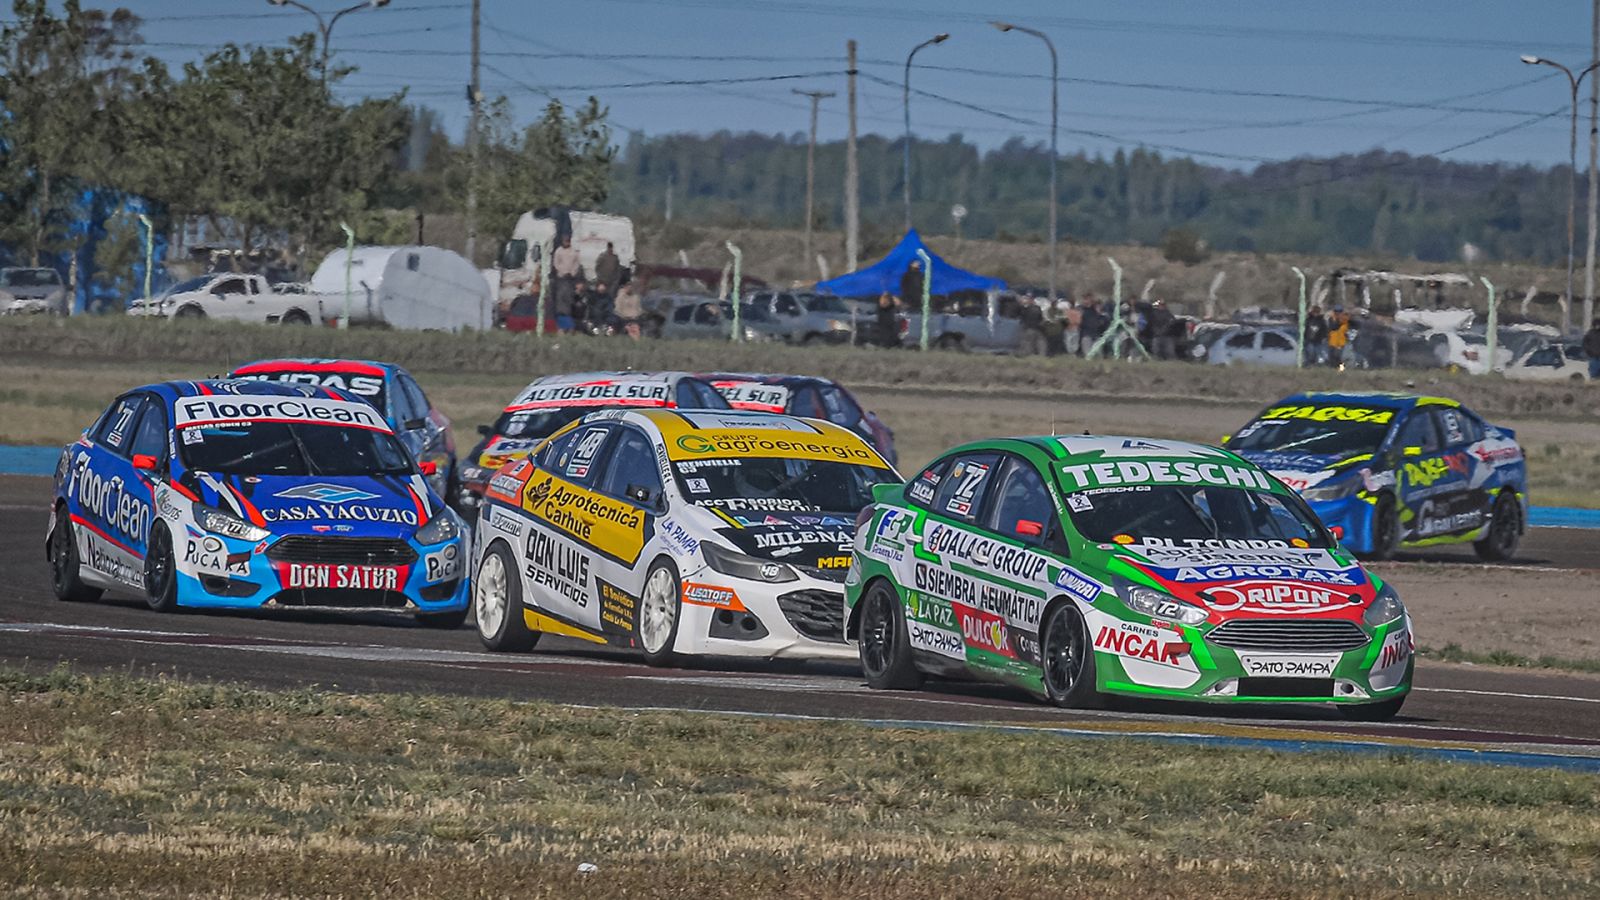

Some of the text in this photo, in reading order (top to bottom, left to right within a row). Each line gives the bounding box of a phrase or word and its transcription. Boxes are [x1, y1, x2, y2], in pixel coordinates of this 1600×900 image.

[524, 385, 665, 402] AUTOS DEL SUR
[745, 390, 781, 404] SUR
[184, 402, 375, 426] FloorClean
[578, 431, 607, 459] 48
[955, 466, 986, 498] 72
[1062, 461, 1272, 490] TEDESCHI
[1083, 487, 1134, 496] TEDESCHI
[261, 504, 418, 526] CASA YACUZIO
[549, 486, 640, 530] Agrotécnica
[227, 522, 242, 534] 77
[661, 516, 675, 533] LA
[671, 525, 700, 556] PAMPA
[754, 531, 855, 549] MILENA
[1142, 537, 1176, 548] DI
[525, 527, 590, 588] DON LUIS
[993, 547, 1047, 580] GROUP
[289, 564, 398, 589] DON SATUR
[525, 564, 589, 608] SERVICIOS
[1175, 565, 1353, 583] AGROTAX
[928, 568, 976, 606] SIEMBRA
[918, 600, 931, 620] LA
[934, 604, 953, 627] PAZ
[1121, 623, 1159, 637] CARNES
[1095, 626, 1180, 665] INCAR
[1251, 661, 1331, 675] PATO PAMPA
